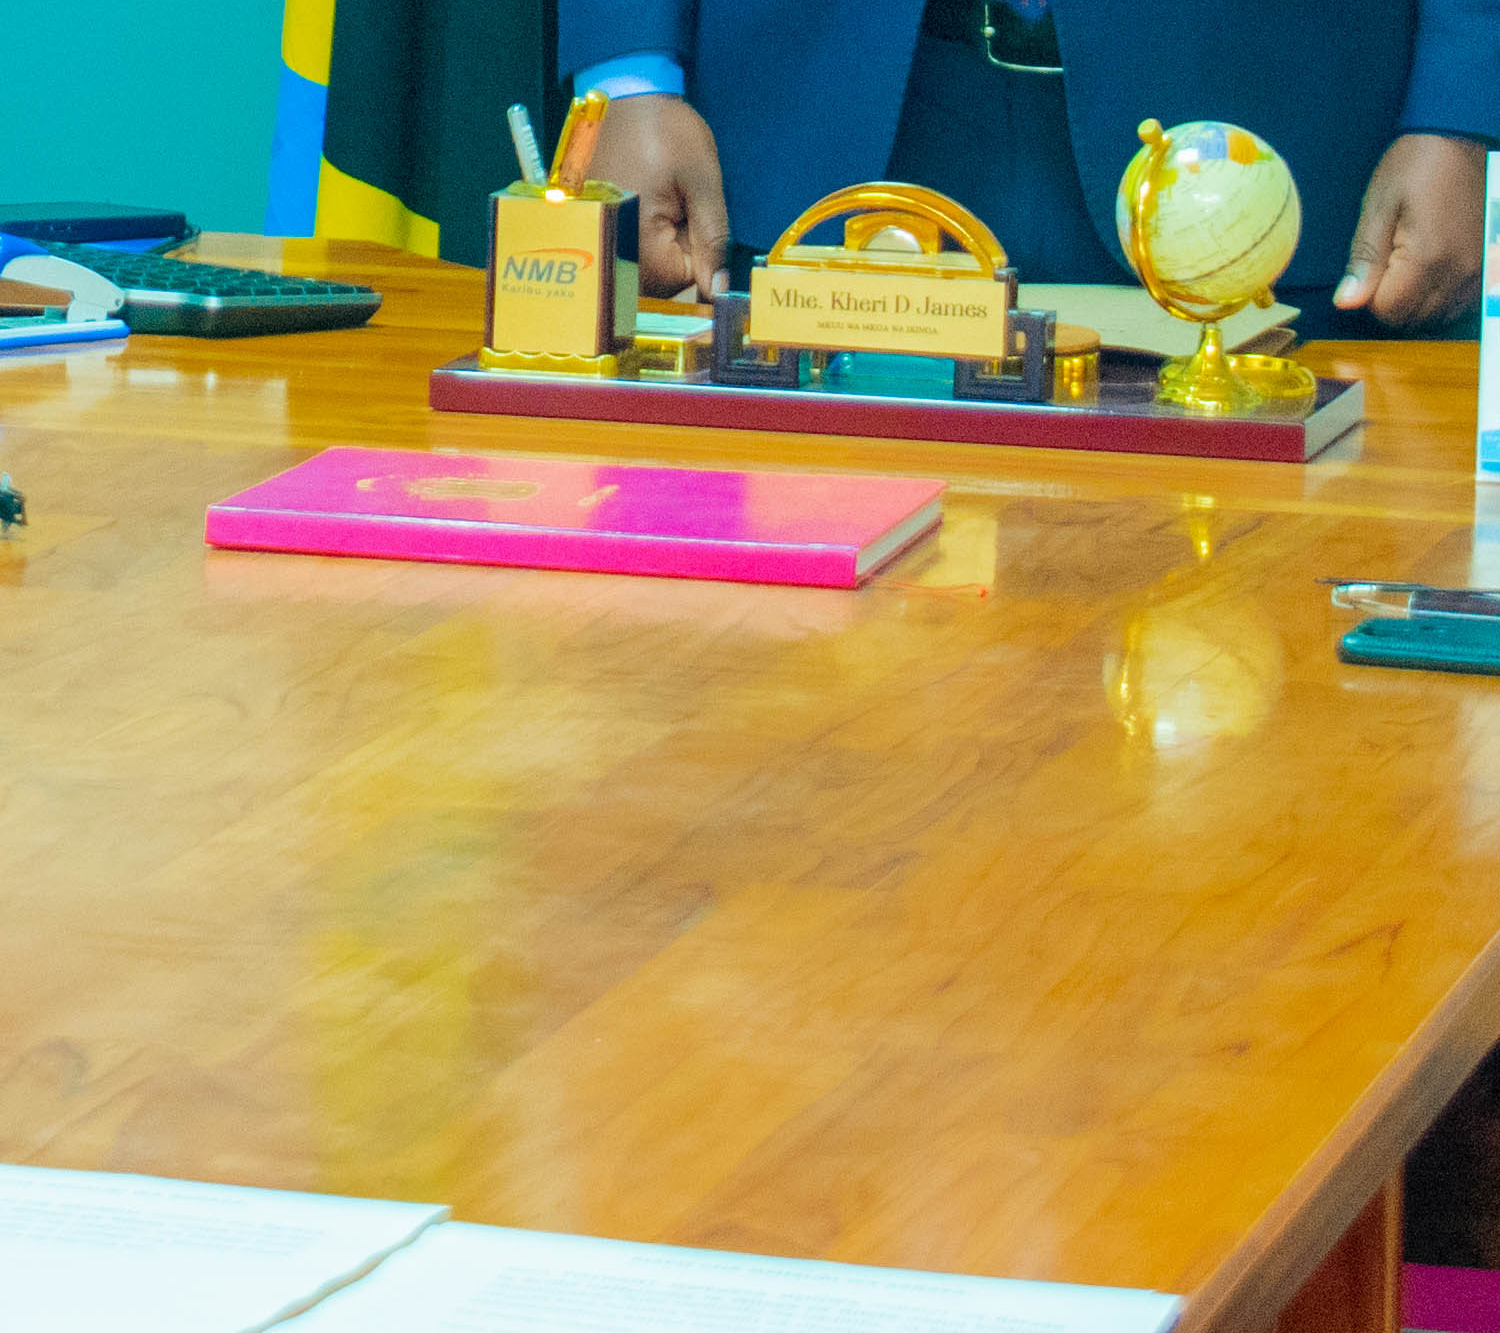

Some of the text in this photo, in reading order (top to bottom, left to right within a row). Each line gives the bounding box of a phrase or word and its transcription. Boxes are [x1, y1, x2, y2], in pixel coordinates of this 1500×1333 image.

[502, 255, 578, 285] NMB
[501, 283, 542, 296] Karibu
[769, 287, 989, 320] Mhe. Kheri D James
